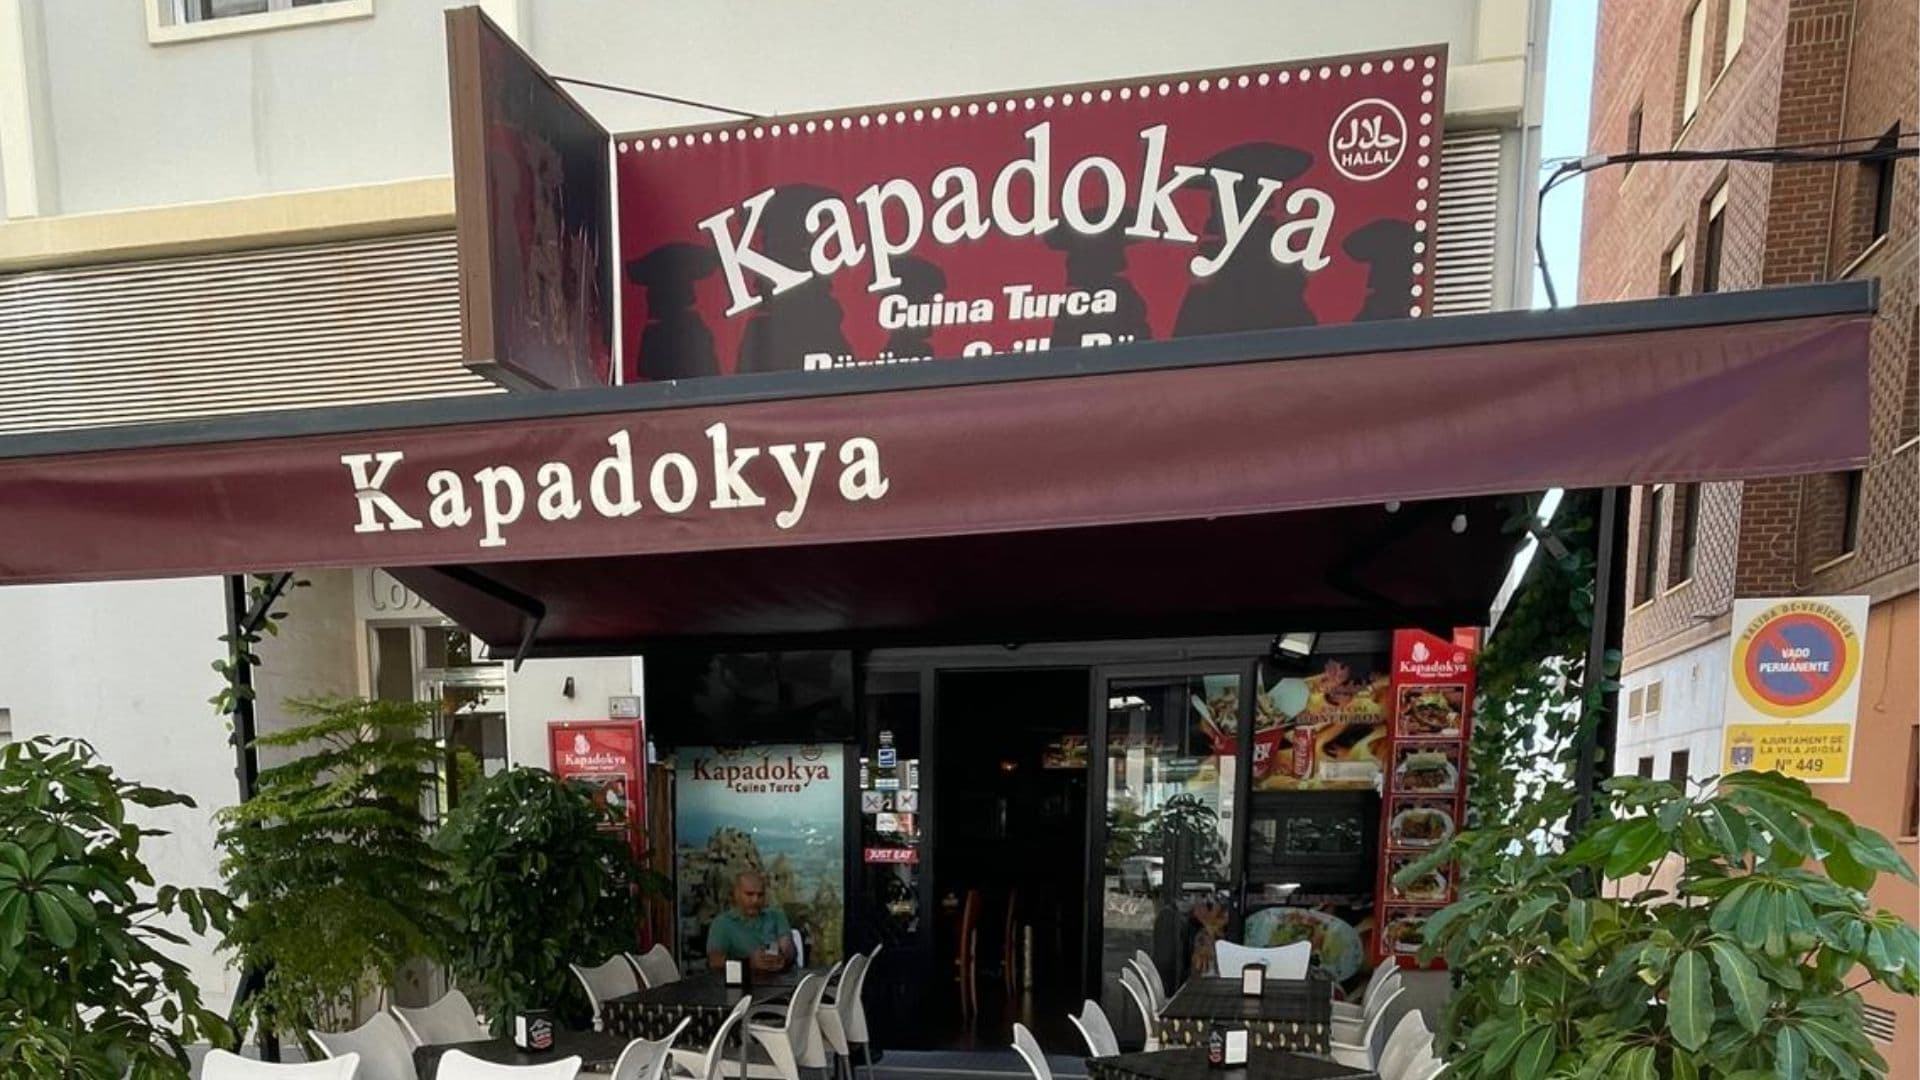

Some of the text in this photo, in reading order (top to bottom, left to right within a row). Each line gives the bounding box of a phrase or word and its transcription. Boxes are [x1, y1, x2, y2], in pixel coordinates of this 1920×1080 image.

[1336, 115, 1400, 150] حلال
[1341, 150, 1393, 167] HALAL
[698, 121, 1336, 319] Kapadokya
[878, 284, 1117, 329] Cuina Turca
[341, 422, 890, 548] Kapadokya
[1781, 647, 1811, 659] VADO
[1400, 660, 1467, 677] Kapadokya
[1759, 661, 1831, 673] PERMANENTE
[1760, 745, 1774, 753] LA
[1776, 745, 1800, 753] VILA
[564, 753, 626, 770] Kapadokya
[1795, 758, 1824, 772] 449
[692, 756, 830, 789] Kapadokya
